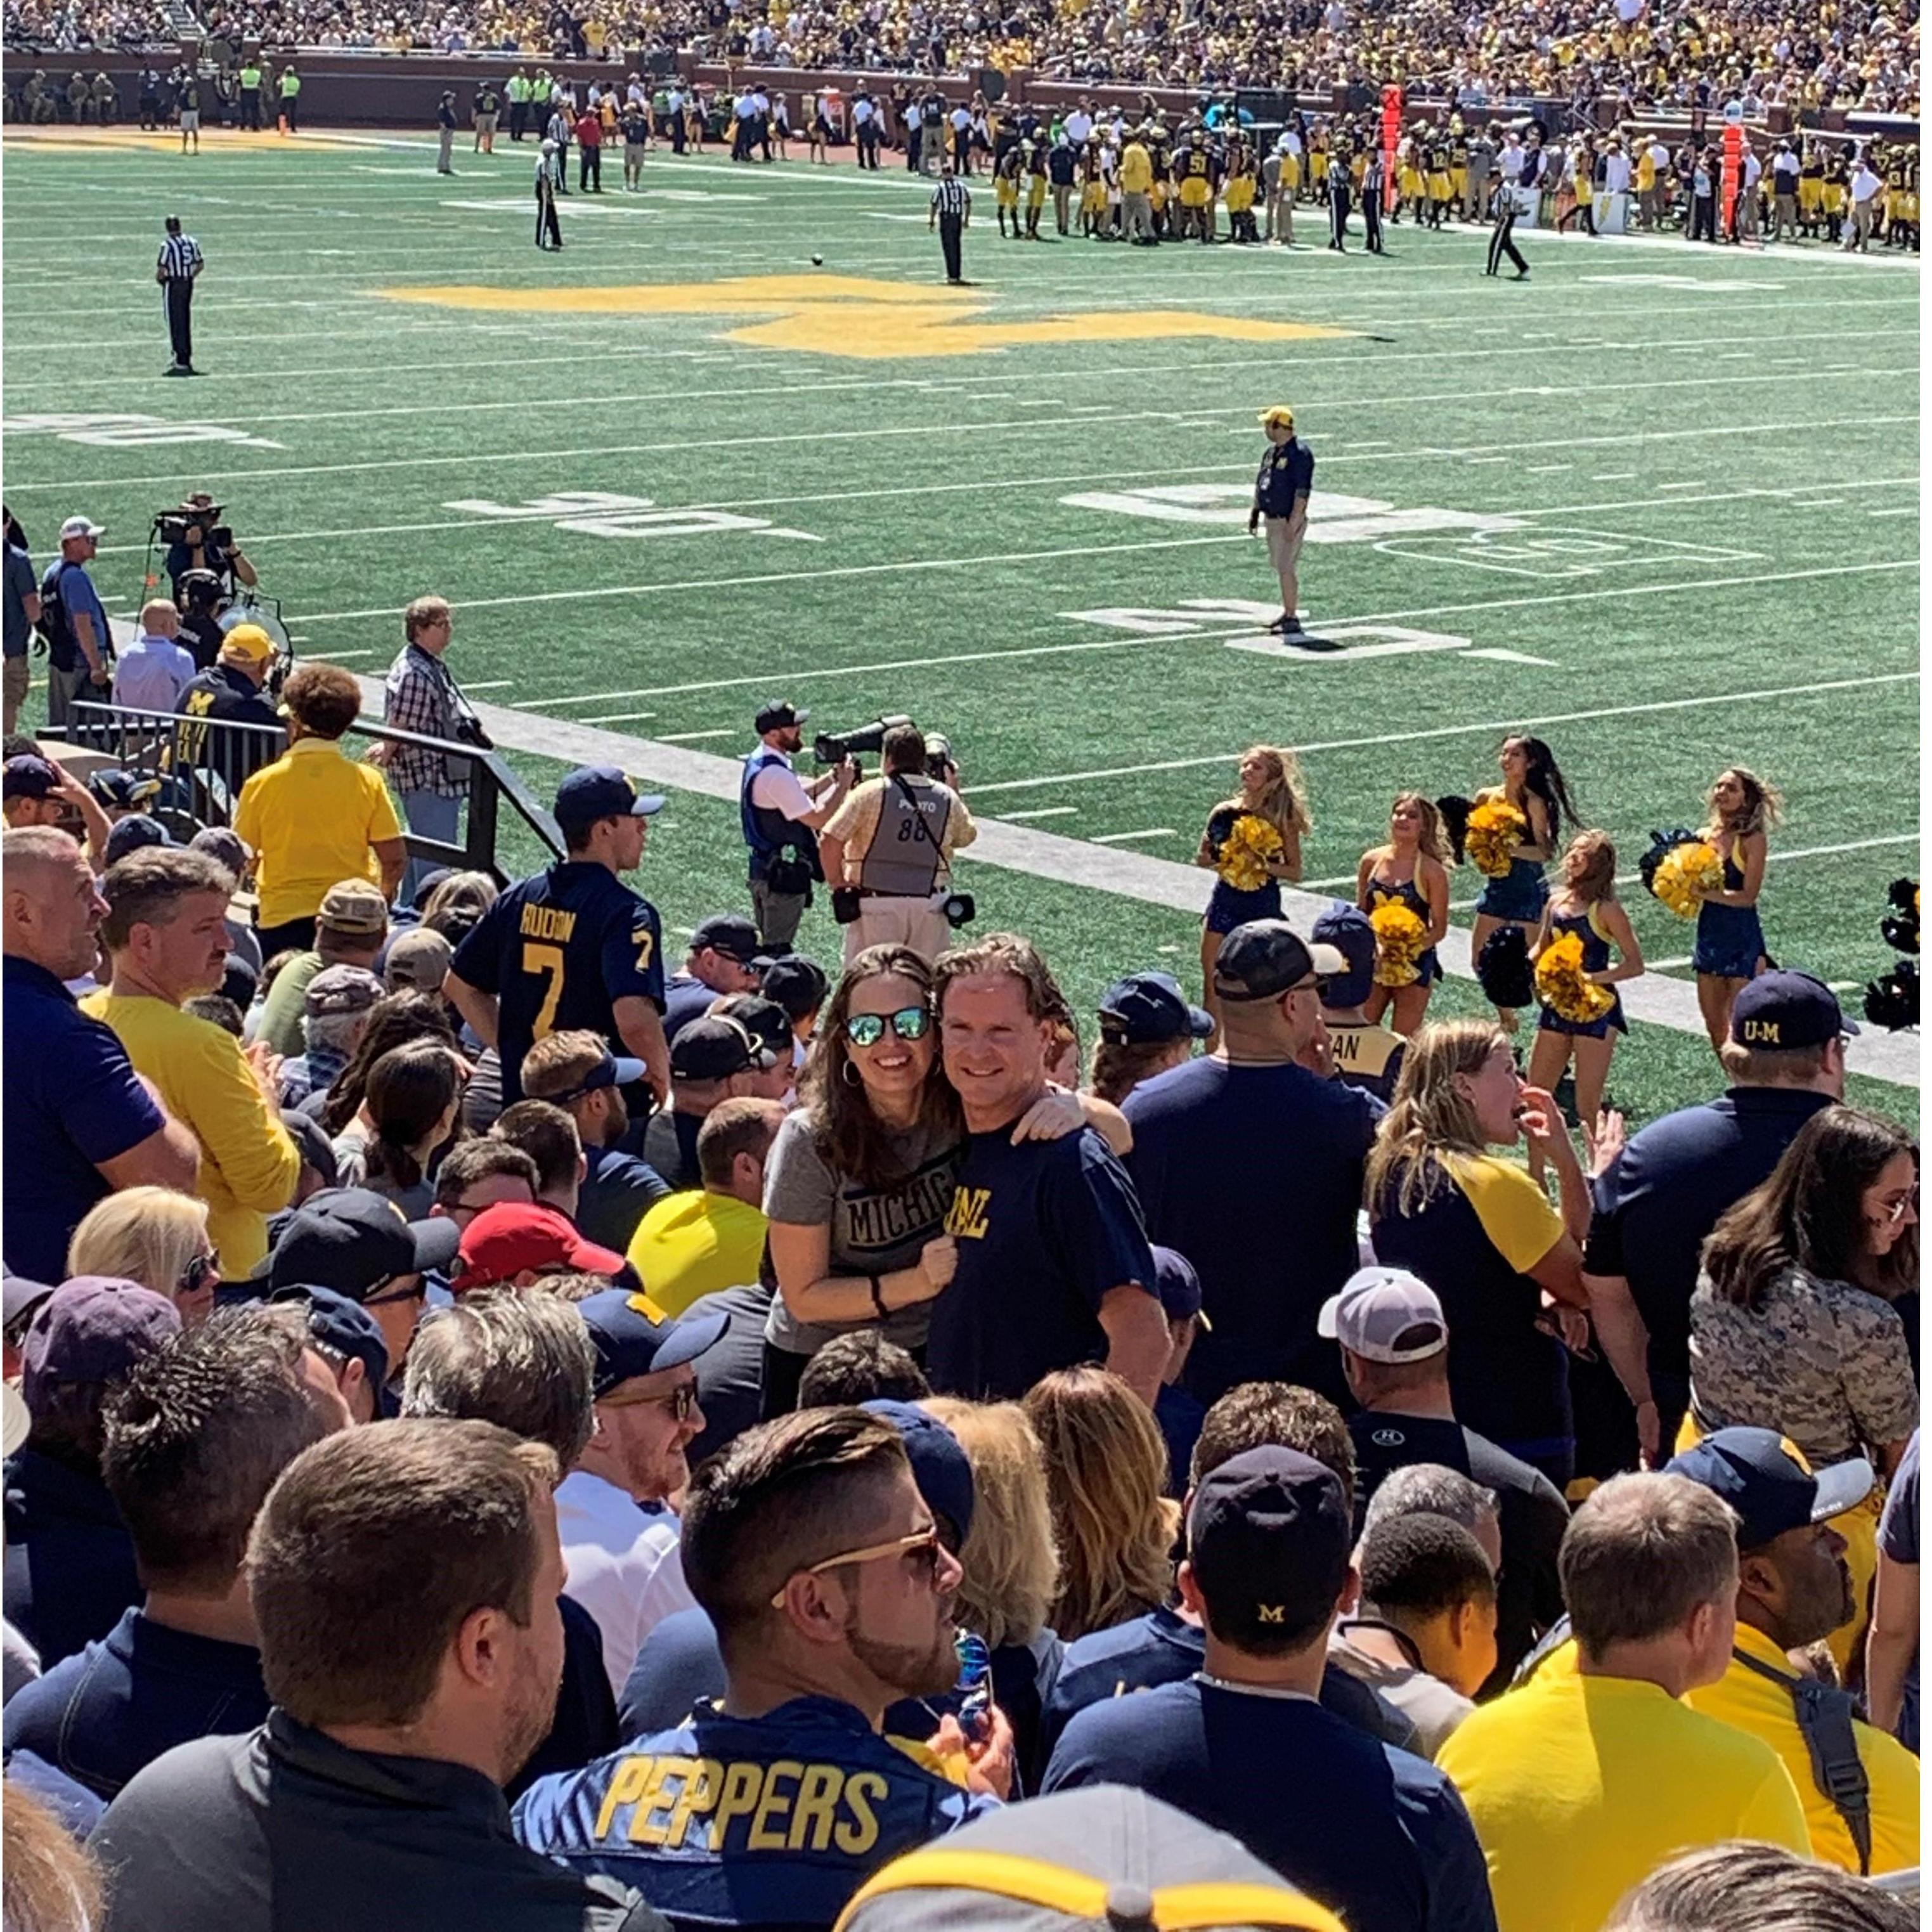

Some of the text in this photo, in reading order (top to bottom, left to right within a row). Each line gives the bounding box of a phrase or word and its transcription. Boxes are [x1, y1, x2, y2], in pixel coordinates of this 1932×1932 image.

[898, 798, 937, 813] PTO
[898, 818, 928, 843] 88
[632, 929, 653, 974] 7
[522, 942, 564, 1041] 7
[1744, 1020, 1780, 1044] U-M
[1257, 1604, 1285, 1623] M
[594, 1754, 888, 1855] PEPPERS
